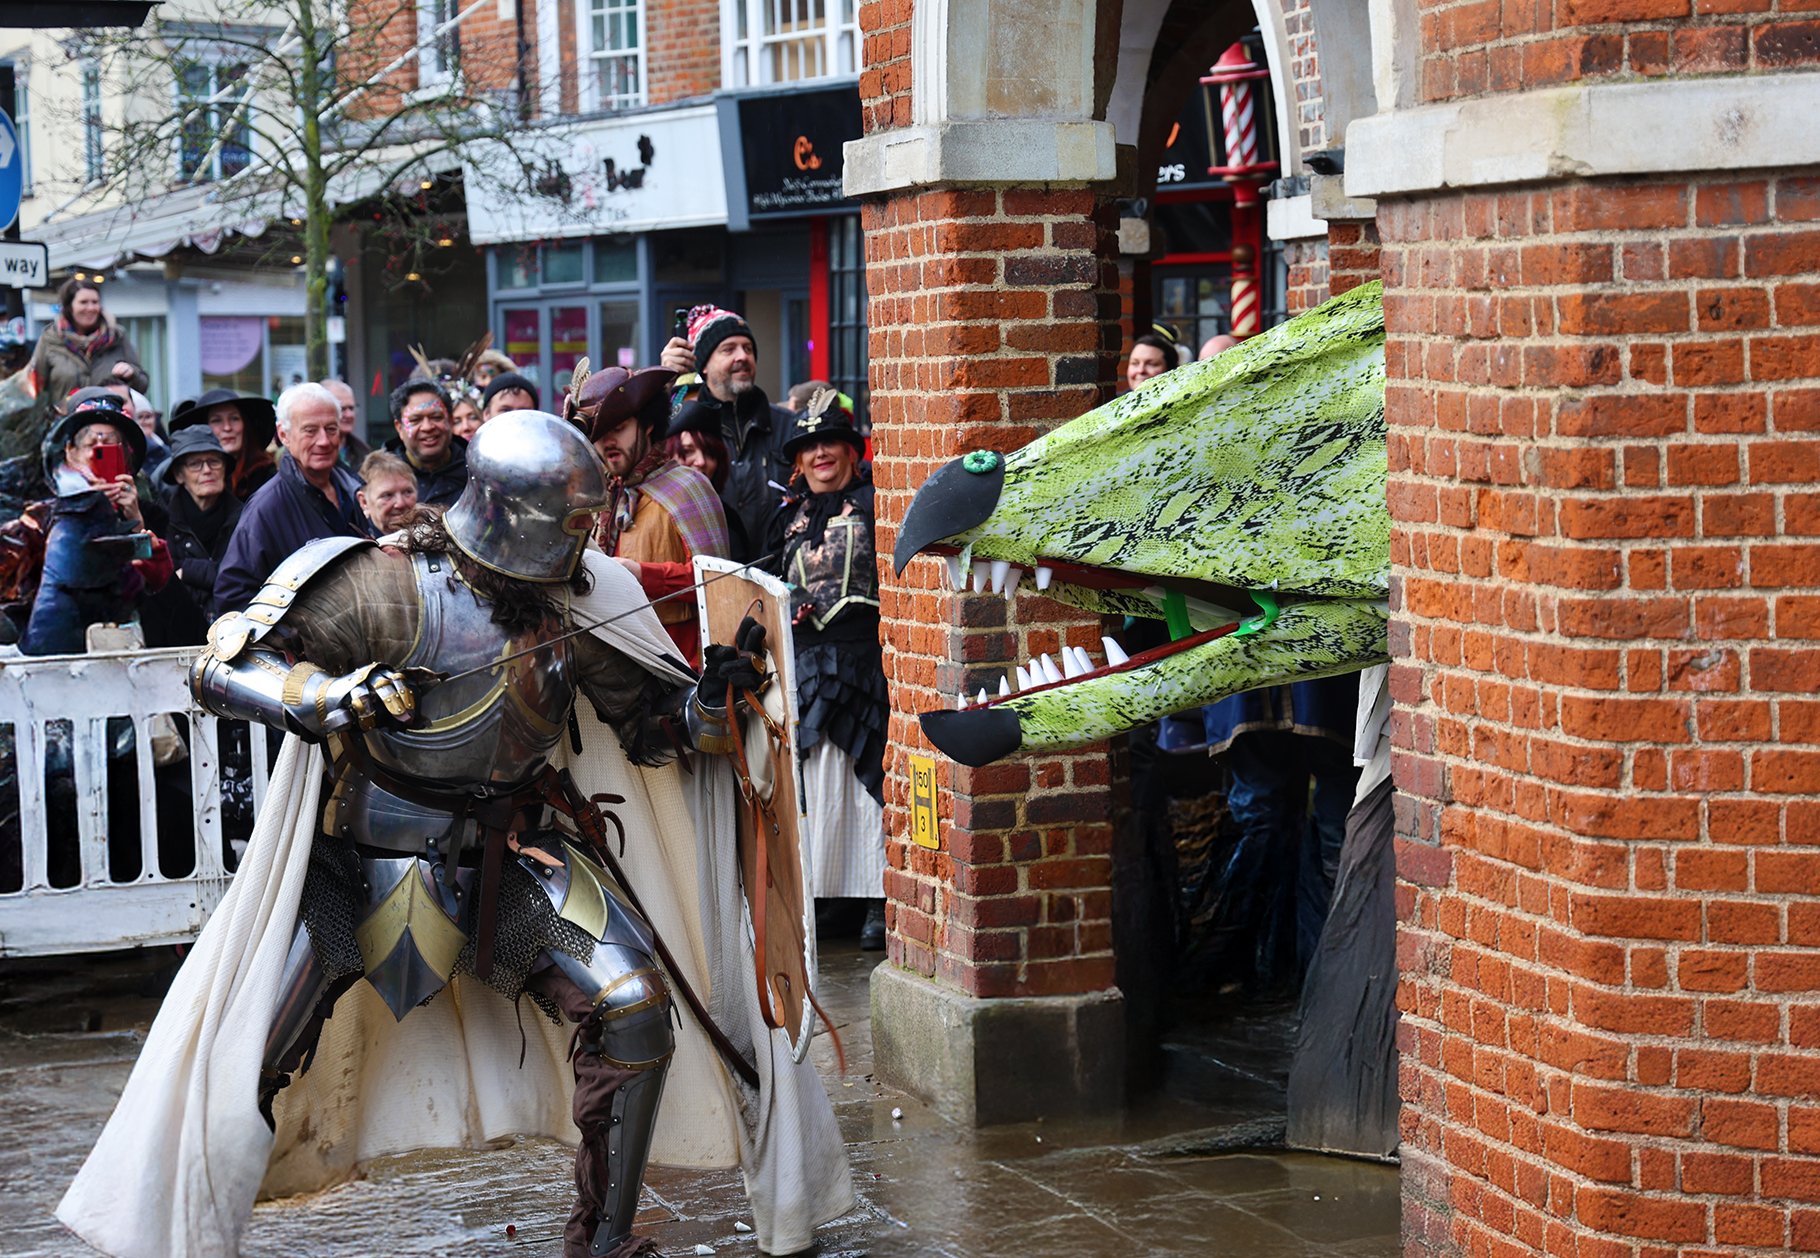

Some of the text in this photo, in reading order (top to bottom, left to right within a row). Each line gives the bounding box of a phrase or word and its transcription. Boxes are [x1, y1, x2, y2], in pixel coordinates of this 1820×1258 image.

[5, 258, 38, 277] way
[915, 771, 929, 788] 150
[920, 815, 926, 832] 3
